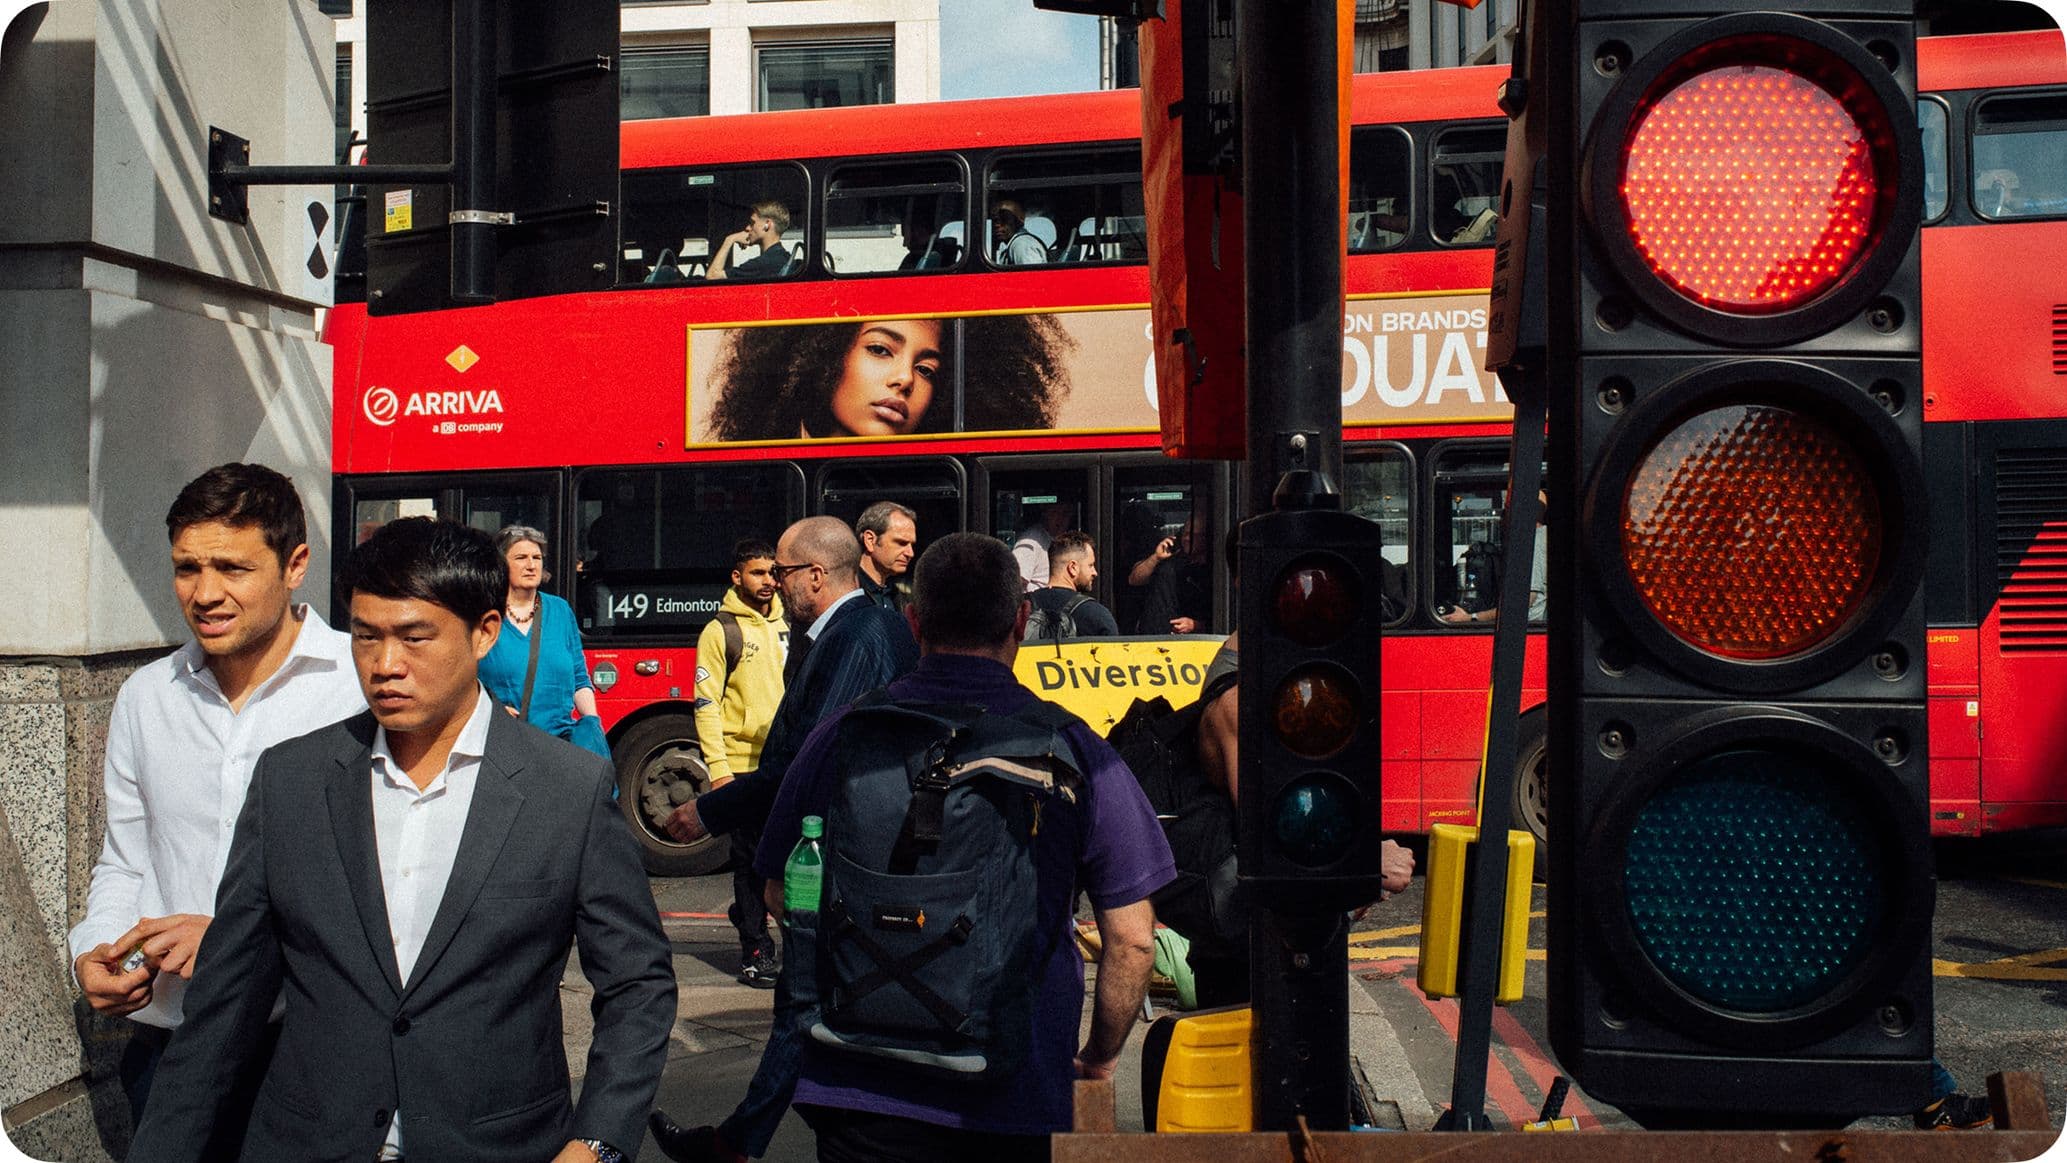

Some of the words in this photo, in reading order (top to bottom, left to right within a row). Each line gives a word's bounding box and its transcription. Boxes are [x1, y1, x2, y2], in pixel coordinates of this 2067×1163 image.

[1382, 309, 1487, 332] BRANDS
[1341, 332, 1508, 408] DUA
[405, 391, 504, 416] ARRIVA
[432, 425, 439, 433] a
[458, 422, 503, 433] company
[607, 593, 649, 619] 149
[656, 598, 721, 613] Edmonton
[1035, 656, 1208, 690] Diversio
